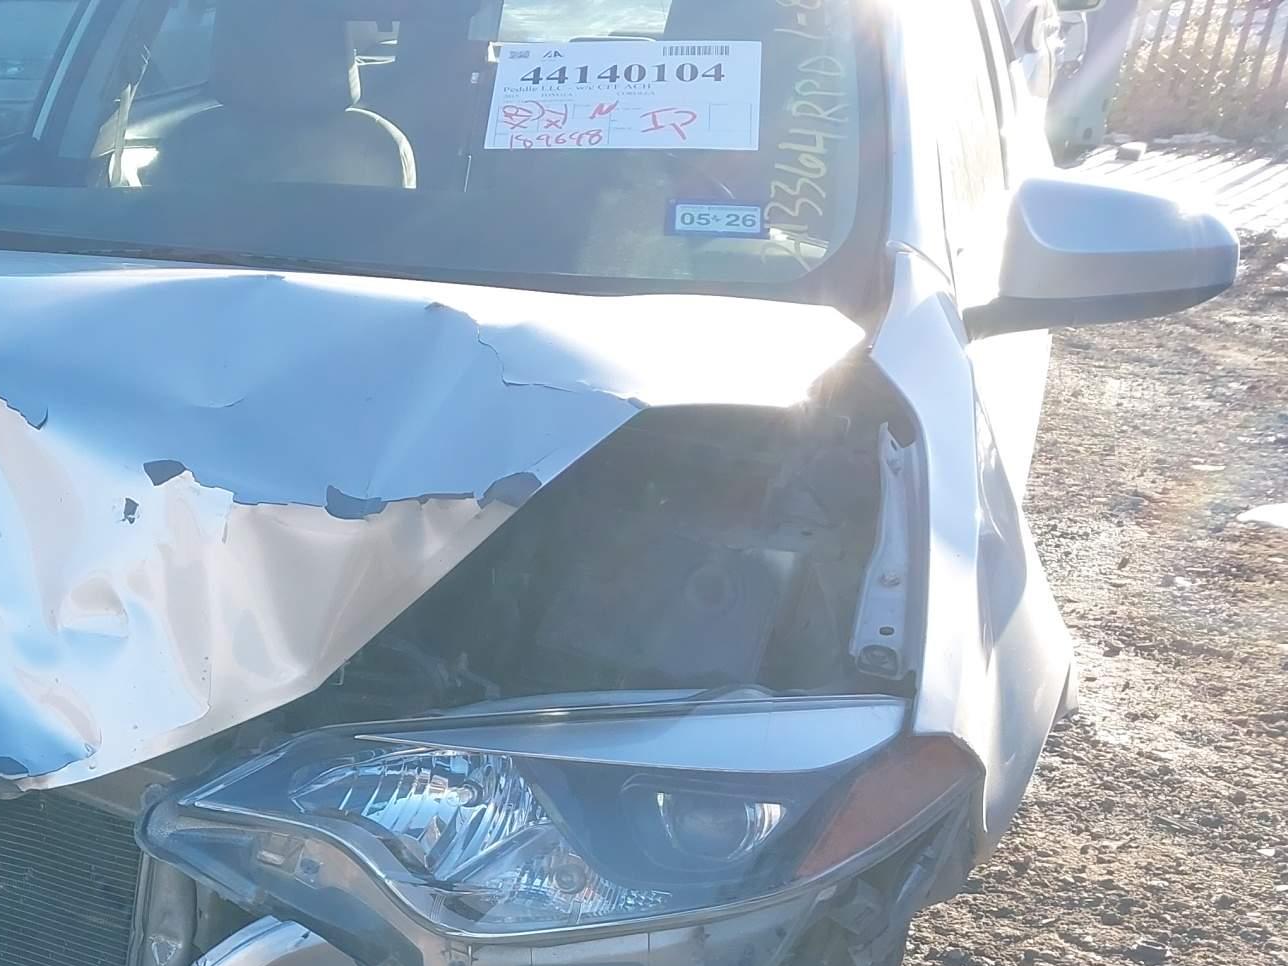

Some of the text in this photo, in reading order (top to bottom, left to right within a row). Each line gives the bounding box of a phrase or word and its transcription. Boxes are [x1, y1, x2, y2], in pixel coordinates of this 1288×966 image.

[520, 63, 725, 85] 44140104
[680, 212, 757, 228] 05 26
